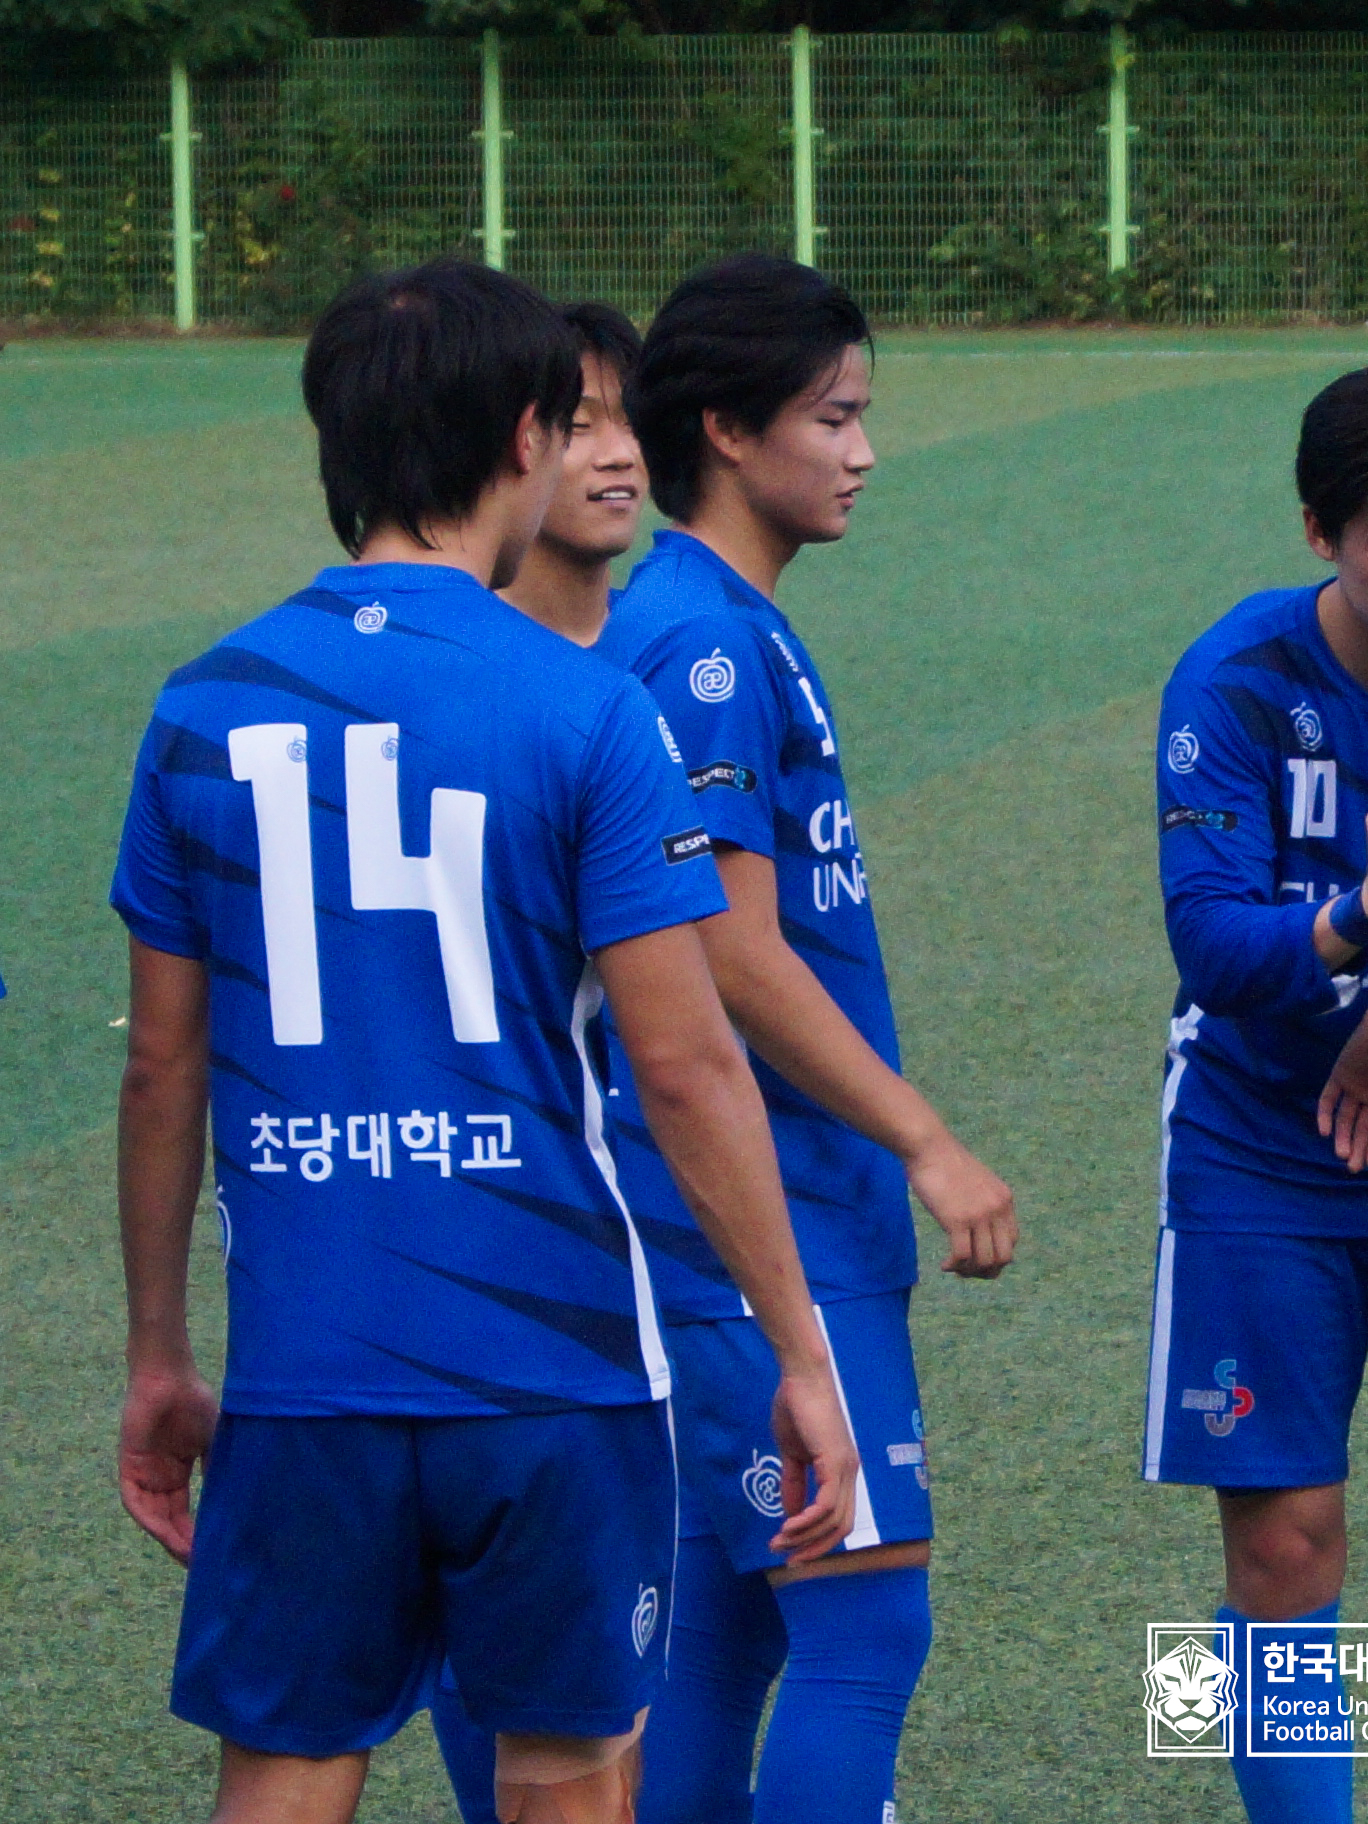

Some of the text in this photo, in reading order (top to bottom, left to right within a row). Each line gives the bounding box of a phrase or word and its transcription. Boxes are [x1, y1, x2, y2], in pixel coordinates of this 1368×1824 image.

[1287, 757, 1338, 839] 10
[228, 722, 500, 1046] 14
[249, 1110, 522, 1182] 초당대학교
